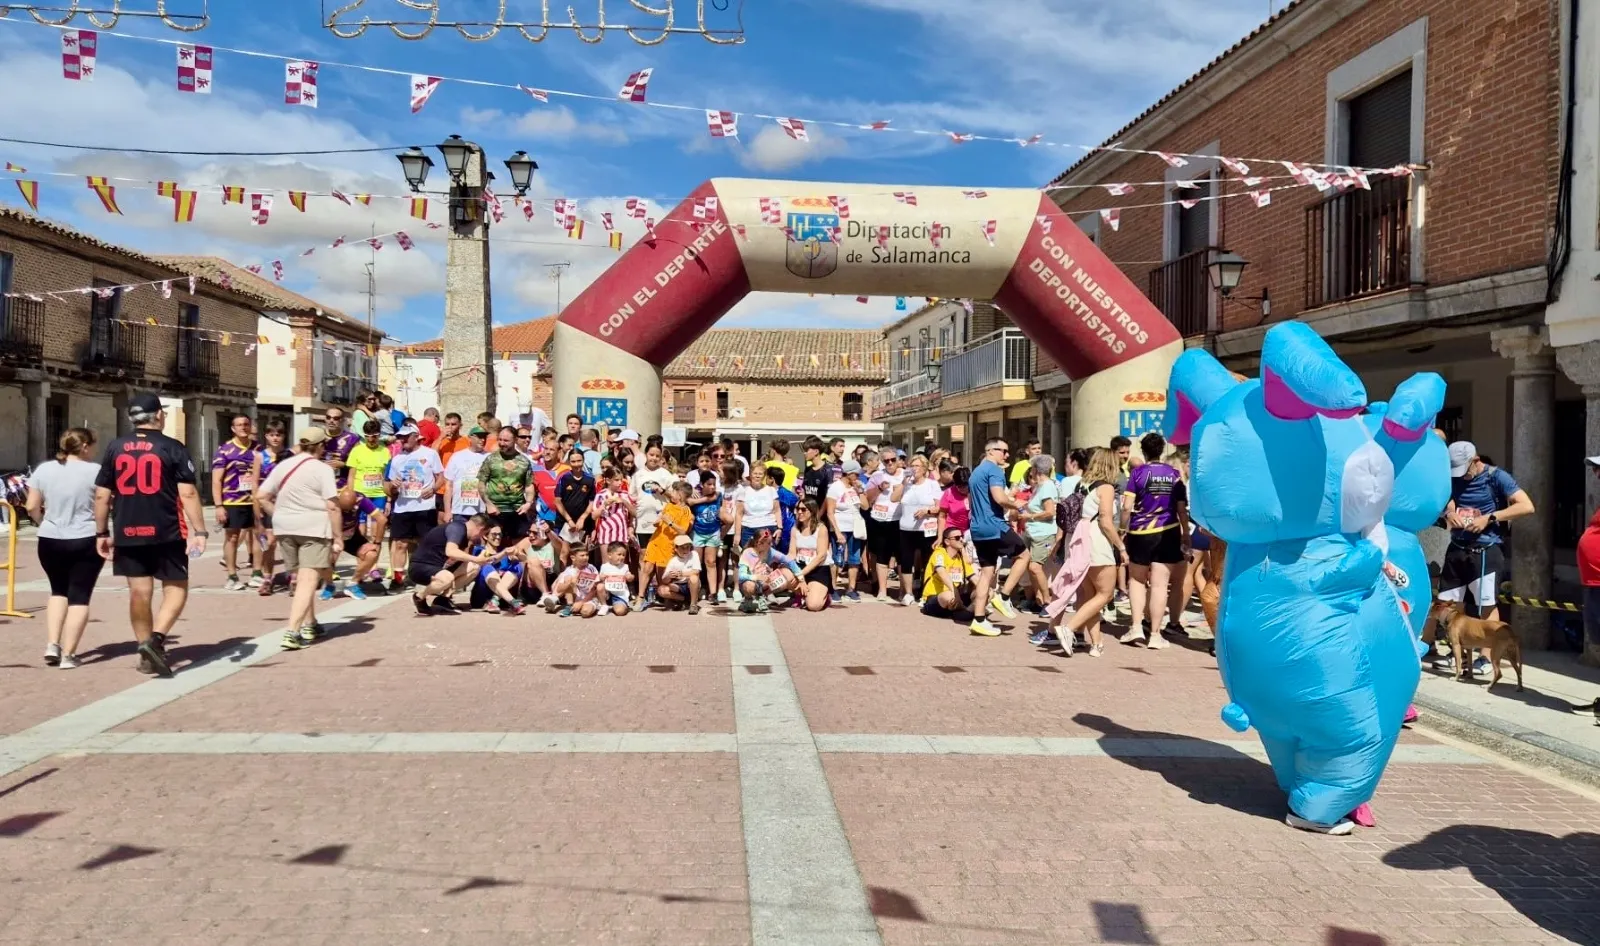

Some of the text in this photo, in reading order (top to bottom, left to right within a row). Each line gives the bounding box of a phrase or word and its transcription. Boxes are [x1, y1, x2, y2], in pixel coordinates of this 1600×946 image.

[599, 218, 728, 337] CON EL DEPORTE
[846, 245, 971, 264] de Salamanca
[1041, 236, 1149, 345] CON NUESTROS
[1029, 257, 1126, 354] DEPORTISTAS
[115, 453, 162, 495] 20
